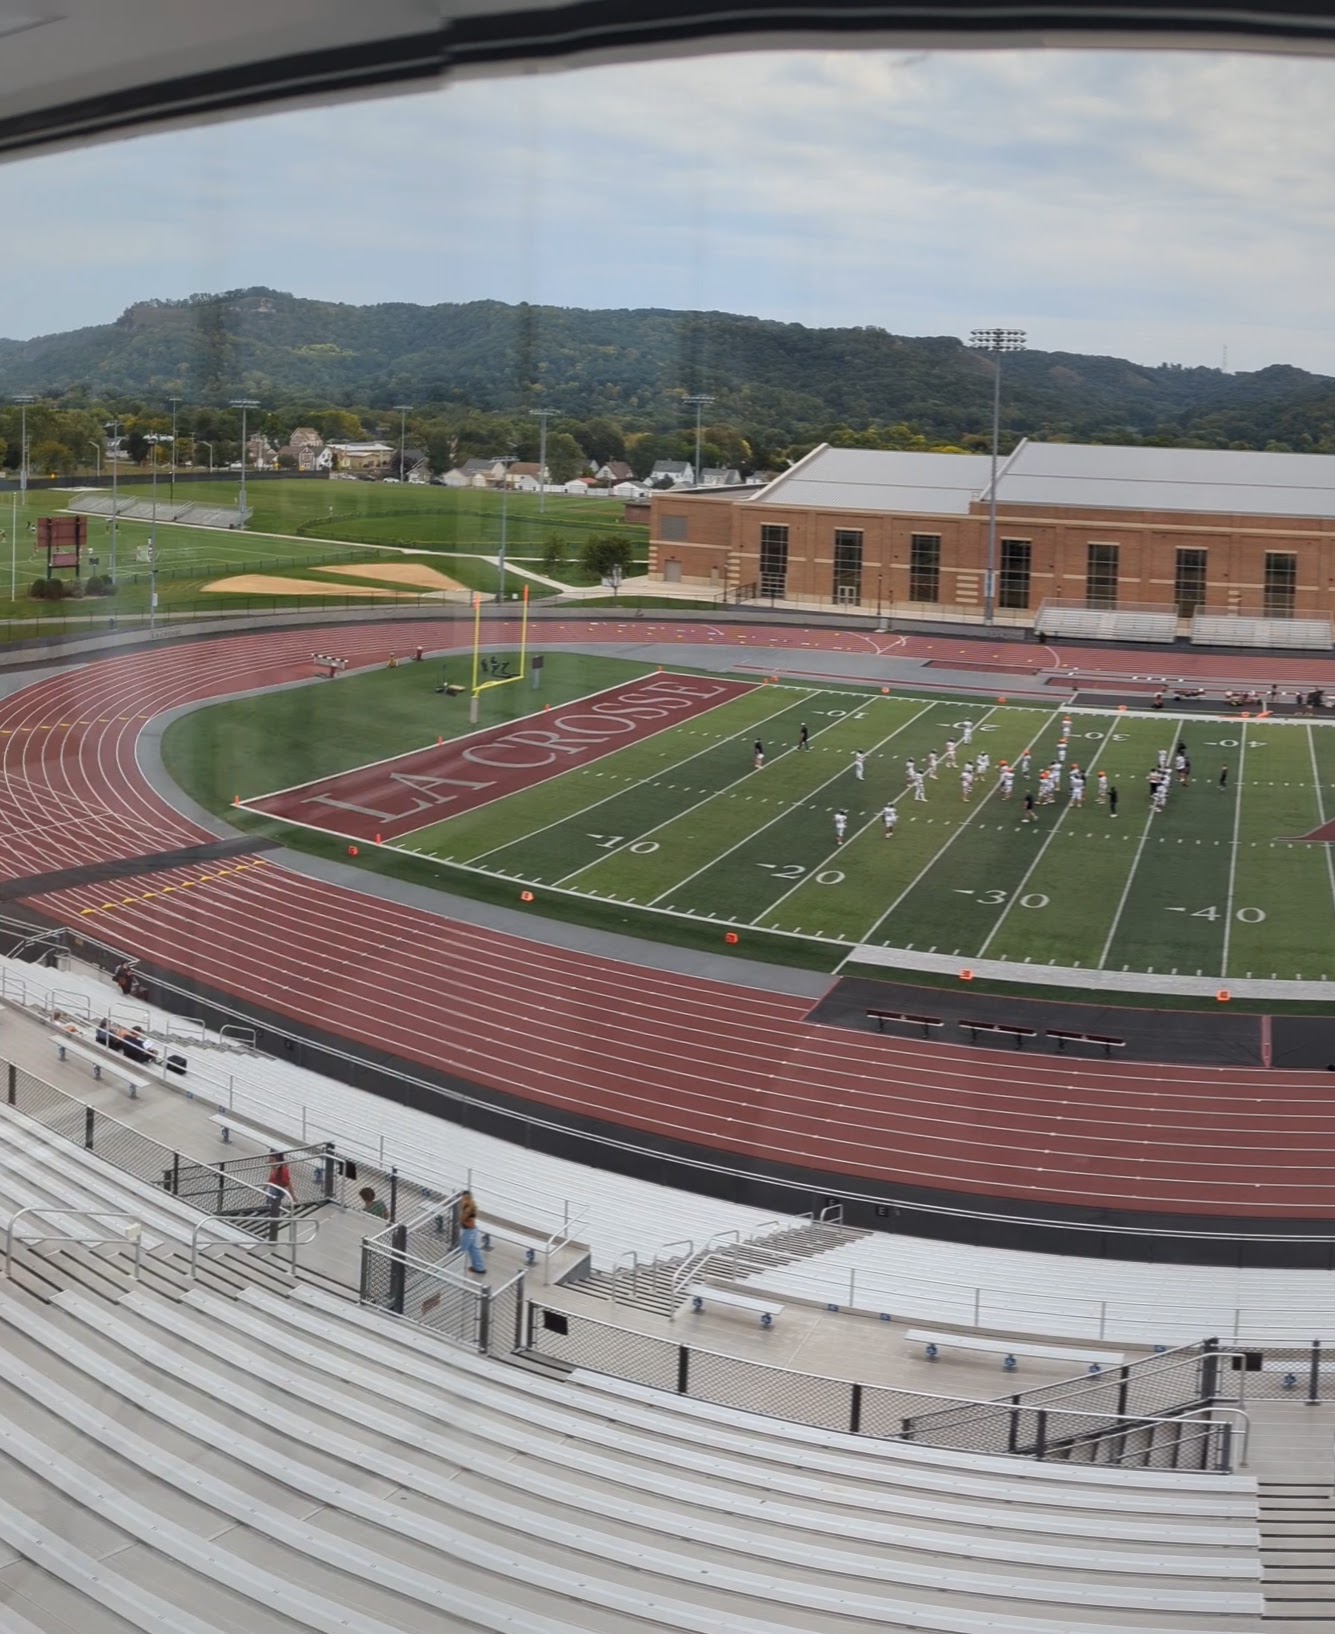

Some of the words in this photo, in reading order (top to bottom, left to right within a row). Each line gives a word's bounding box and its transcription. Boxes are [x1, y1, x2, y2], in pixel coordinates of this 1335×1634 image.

[301, 771, 498, 824] LA
[461, 681, 729, 769] CROSSE
[595, 835, 661, 854] 10
[770, 864, 846, 885] 20
[976, 889, 1050, 909] 30
[1190, 905, 1267, 924] 40
